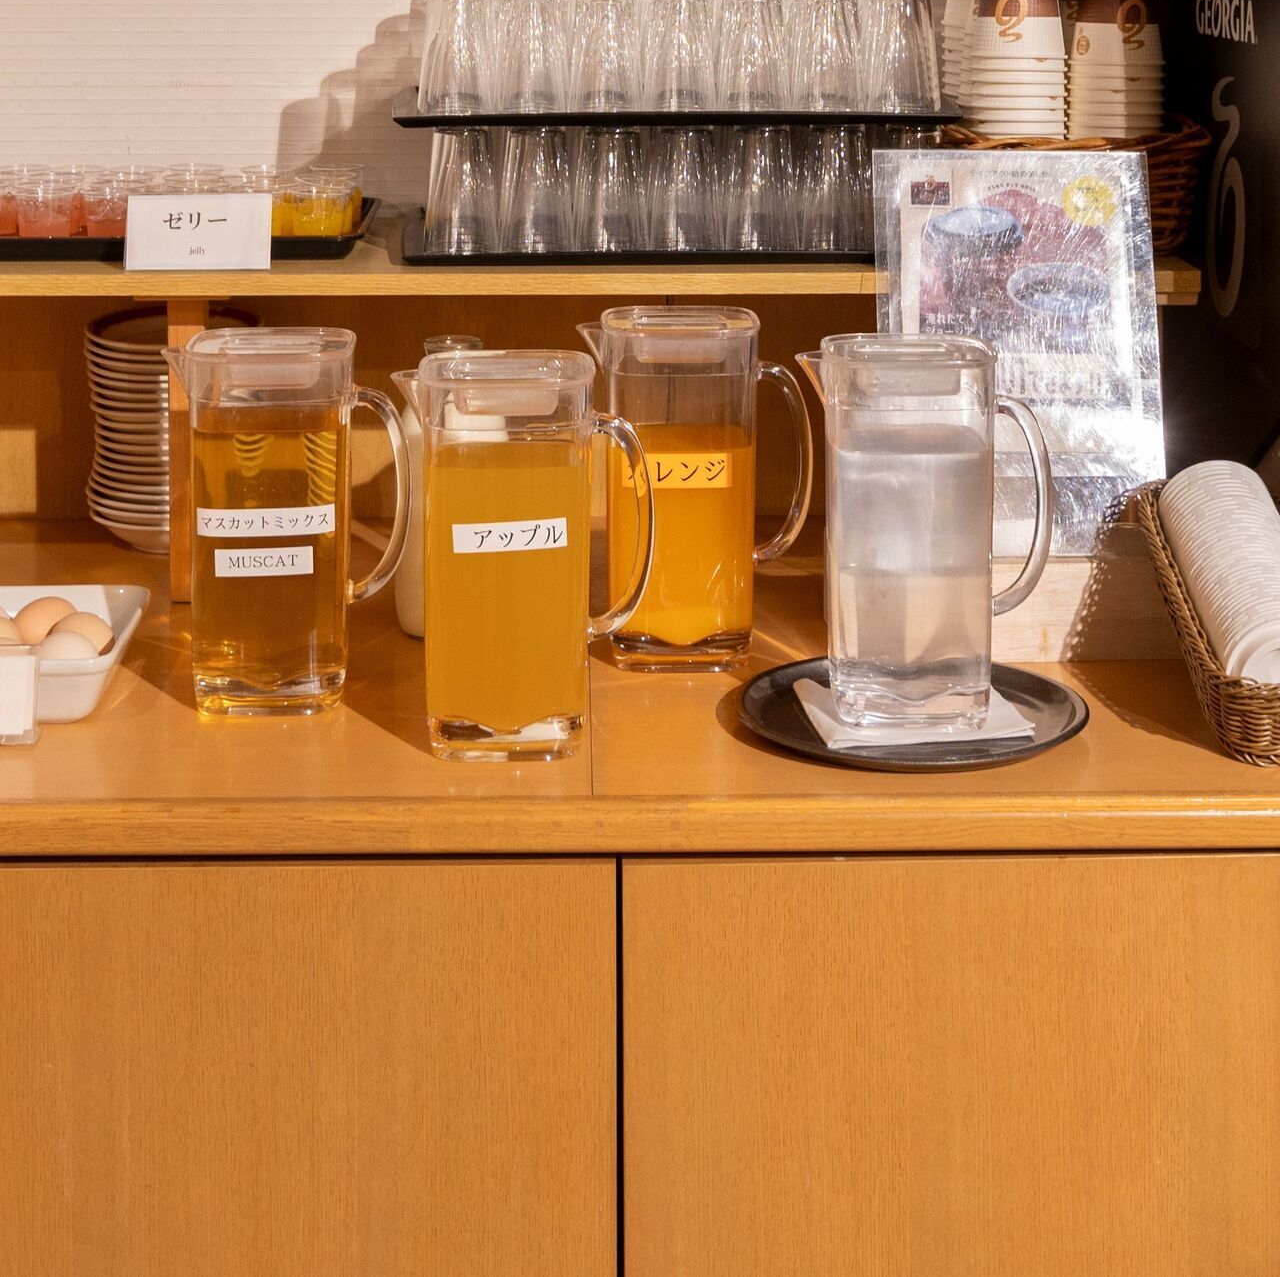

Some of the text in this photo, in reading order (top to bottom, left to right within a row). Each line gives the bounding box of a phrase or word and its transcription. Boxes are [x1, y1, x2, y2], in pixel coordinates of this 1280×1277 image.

[163, 211, 228, 231] ゼリー
[188, 246, 206, 256] jelly
[200, 511, 330, 532] マスカットミックス
[473, 523, 563, 549] アップル
[227, 553, 299, 570] MUSCAT
